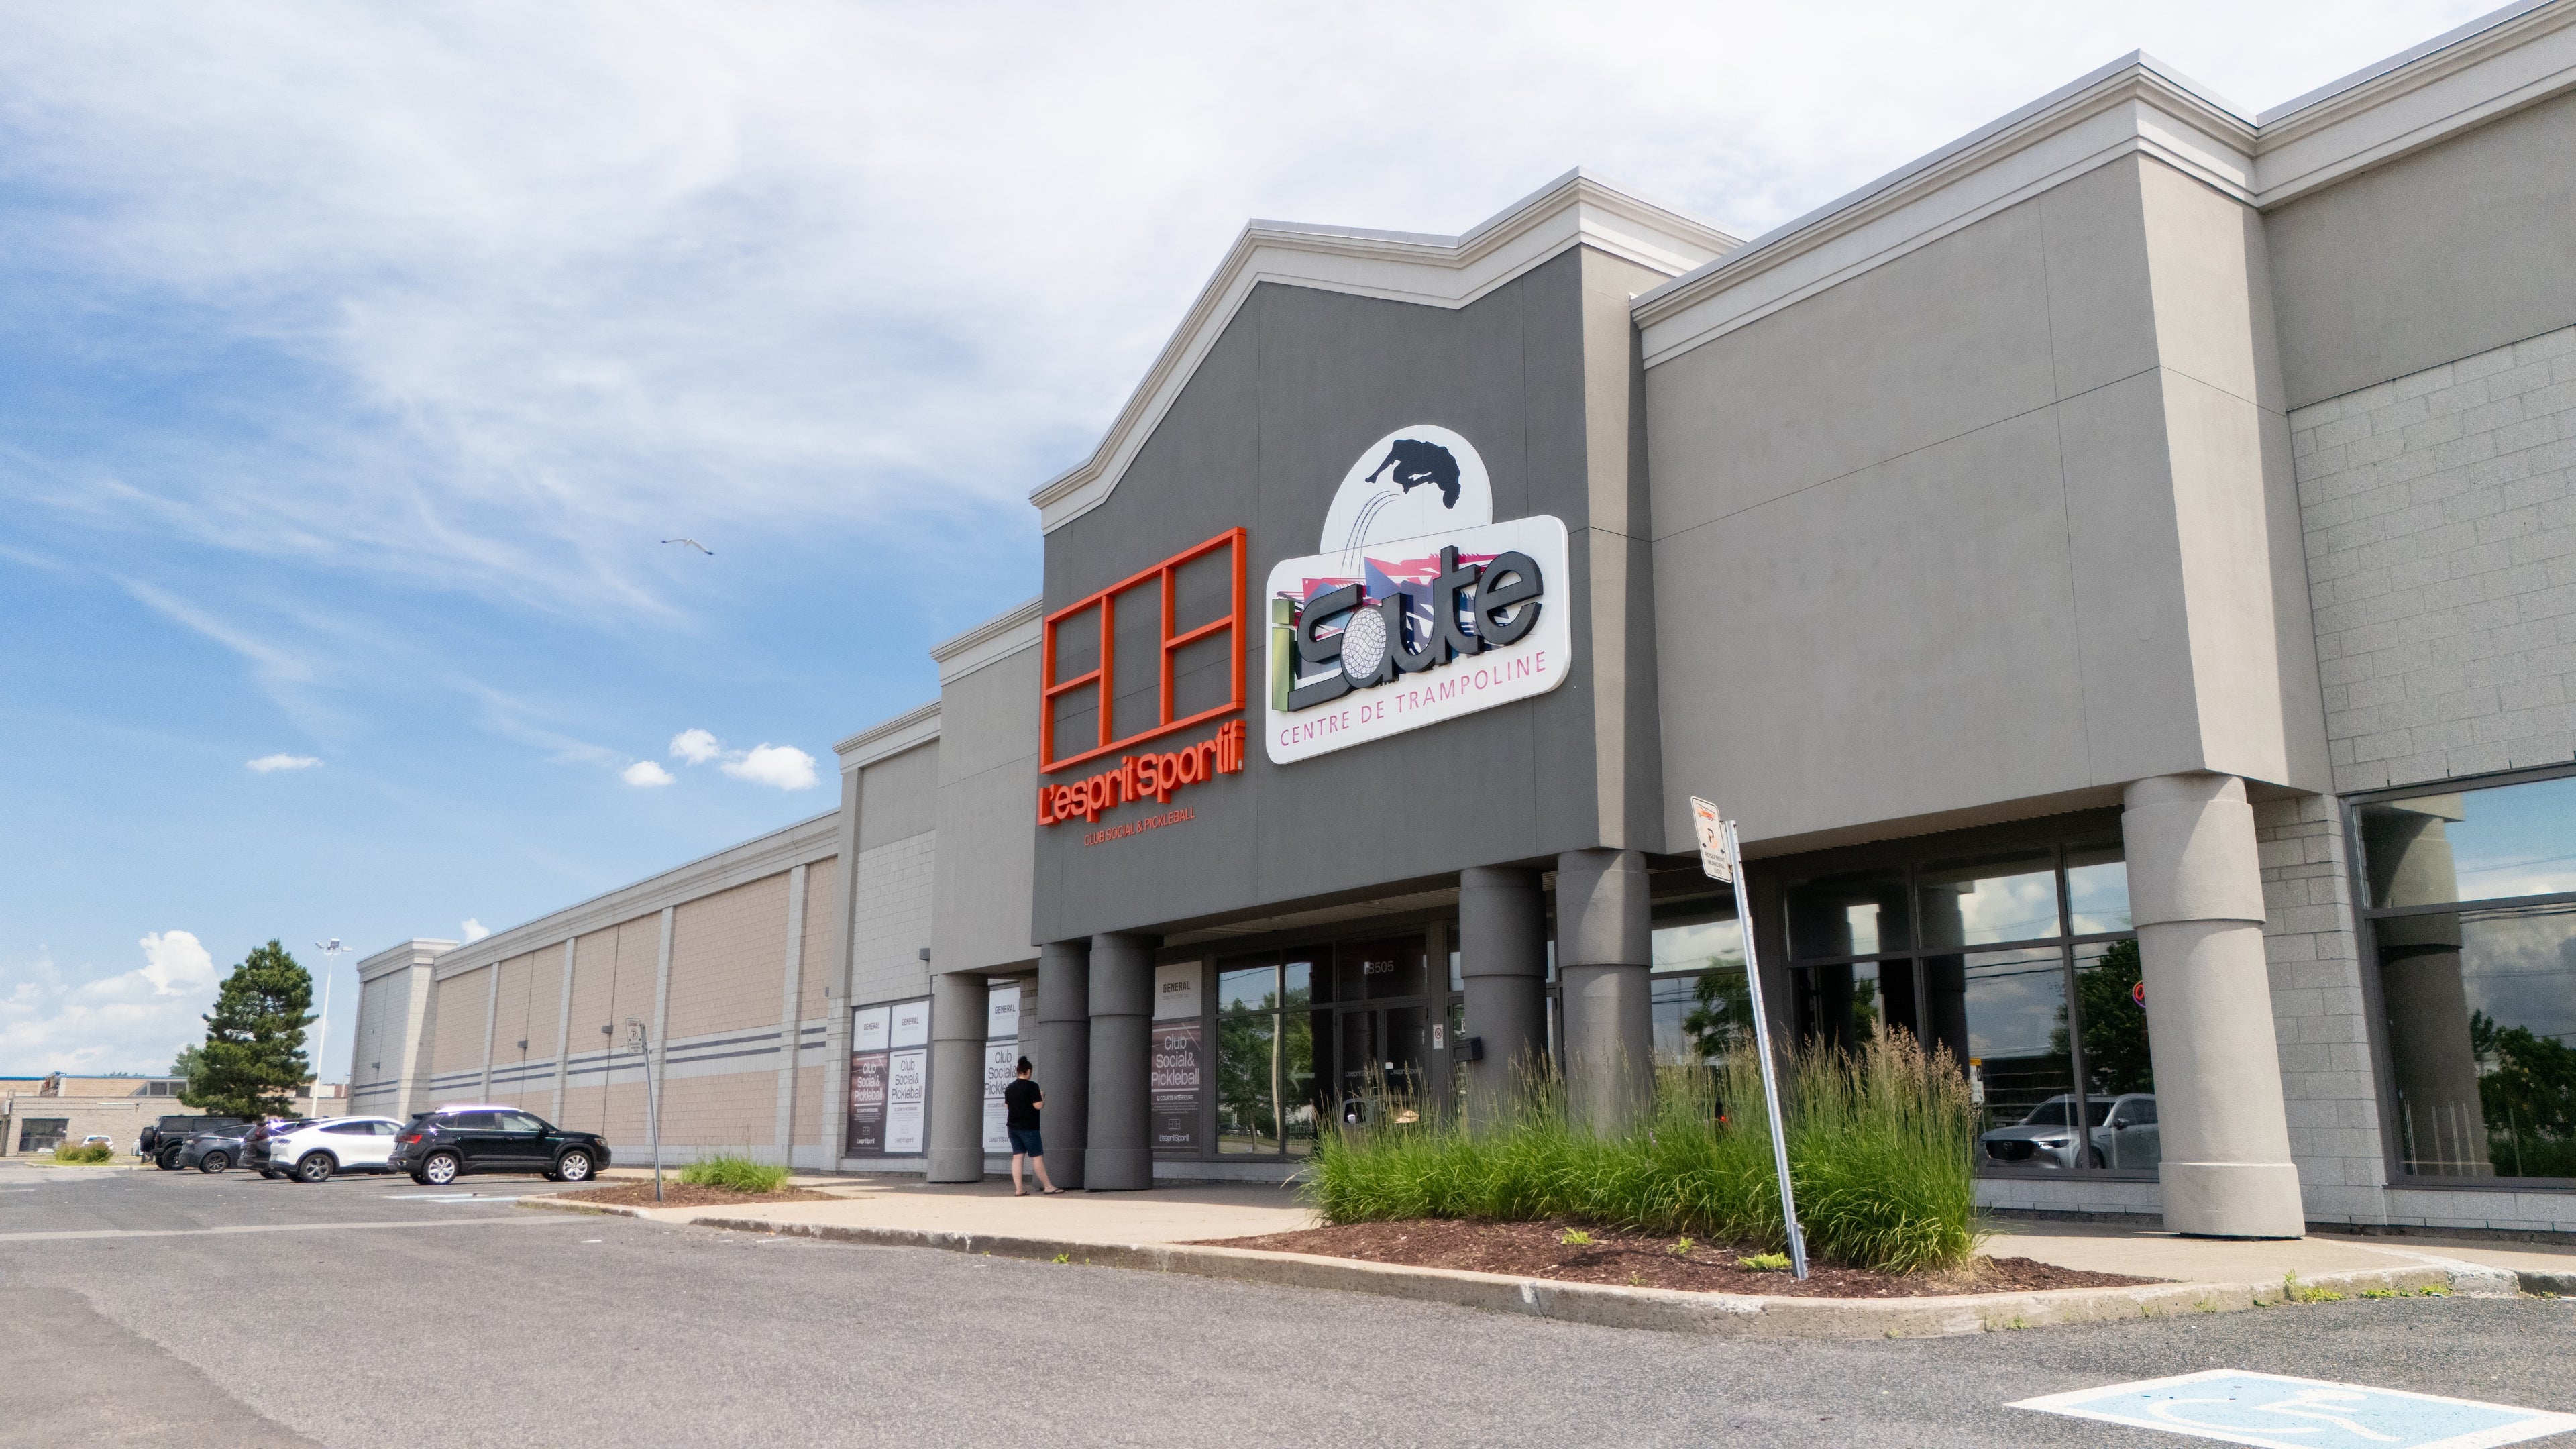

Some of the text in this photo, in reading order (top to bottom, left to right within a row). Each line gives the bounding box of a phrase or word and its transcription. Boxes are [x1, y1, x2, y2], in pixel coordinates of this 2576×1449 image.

[1280, 651, 1546, 747] CENTRE DE TRAMPOLINE
[1038, 755, 1138, 826] L'esprit
[1084, 806, 1195, 847] CLUB SOCIAL & PICKLEBALL
[1368, 960, 1394, 974] 8505
[1163, 981, 1191, 993] GENERAL
[995, 1004, 1016, 1014] GENERAL
[863, 1022, 880, 1030] GENERAL
[902, 1017, 919, 1026] GENERAL
[1165, 1033, 1187, 1050] Club
[995, 1049, 1012, 1063] Club
[863, 1061, 877, 1074] Club
[901, 1058, 915, 1071] Club
[1151, 1068, 1200, 1087] Pickleball
[854, 1087, 883, 1102] Pickleball
[892, 1085, 922, 1100] Pickleball
[985, 1080, 1009, 1095] Pickle
